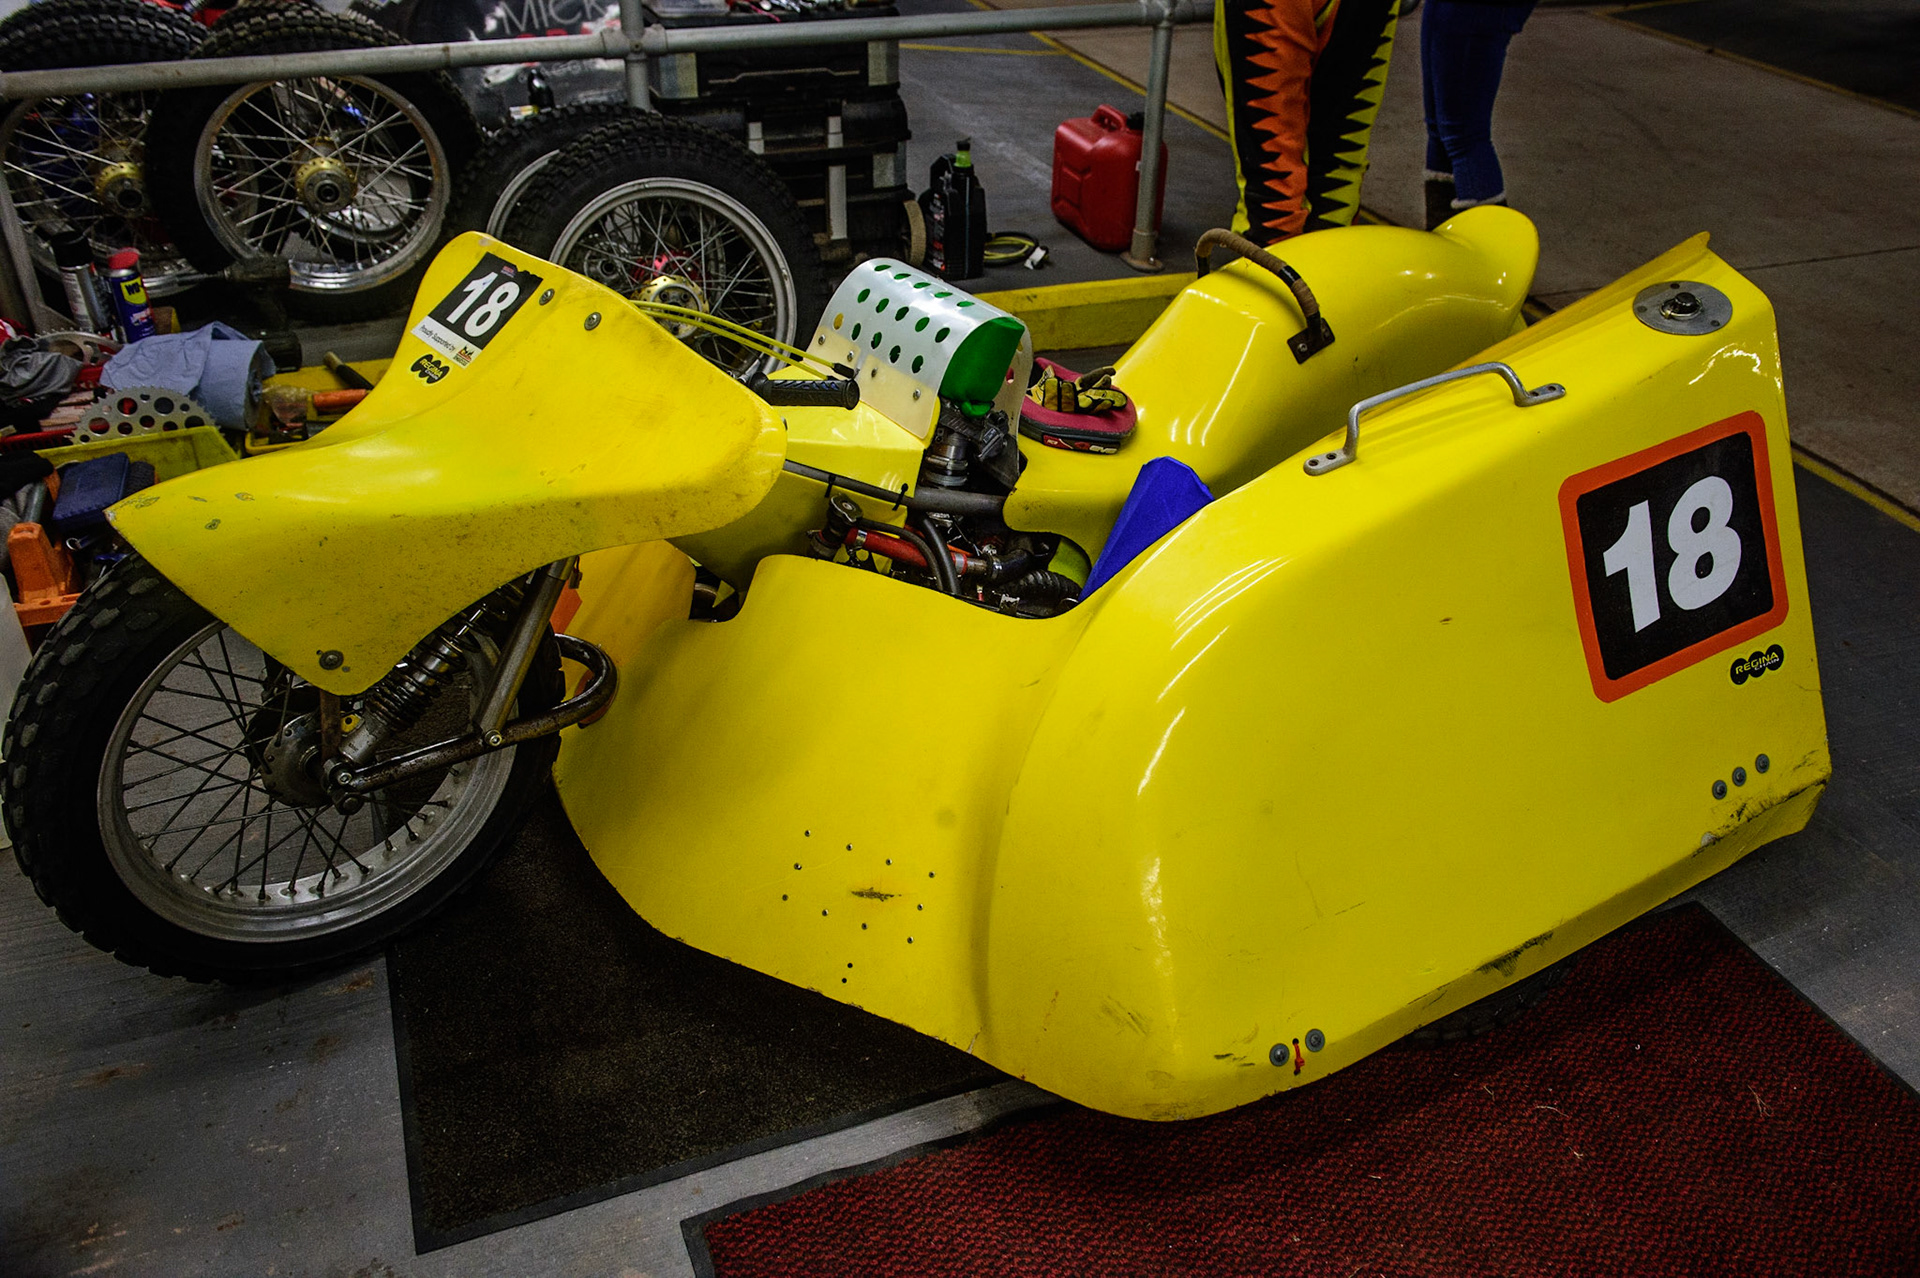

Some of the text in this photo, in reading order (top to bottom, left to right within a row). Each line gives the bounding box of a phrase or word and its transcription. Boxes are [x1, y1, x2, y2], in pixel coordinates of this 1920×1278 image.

[500, 0, 608, 34] MICK
[446, 271, 520, 338] 18
[420, 323, 435, 339] Proudly
[431, 331, 453, 350] Supported
[420, 358, 443, 377] REGINA
[1603, 475, 1742, 633] 18
[1735, 651, 1779, 675] REGINA
[1754, 657, 1780, 671] CHAIN
